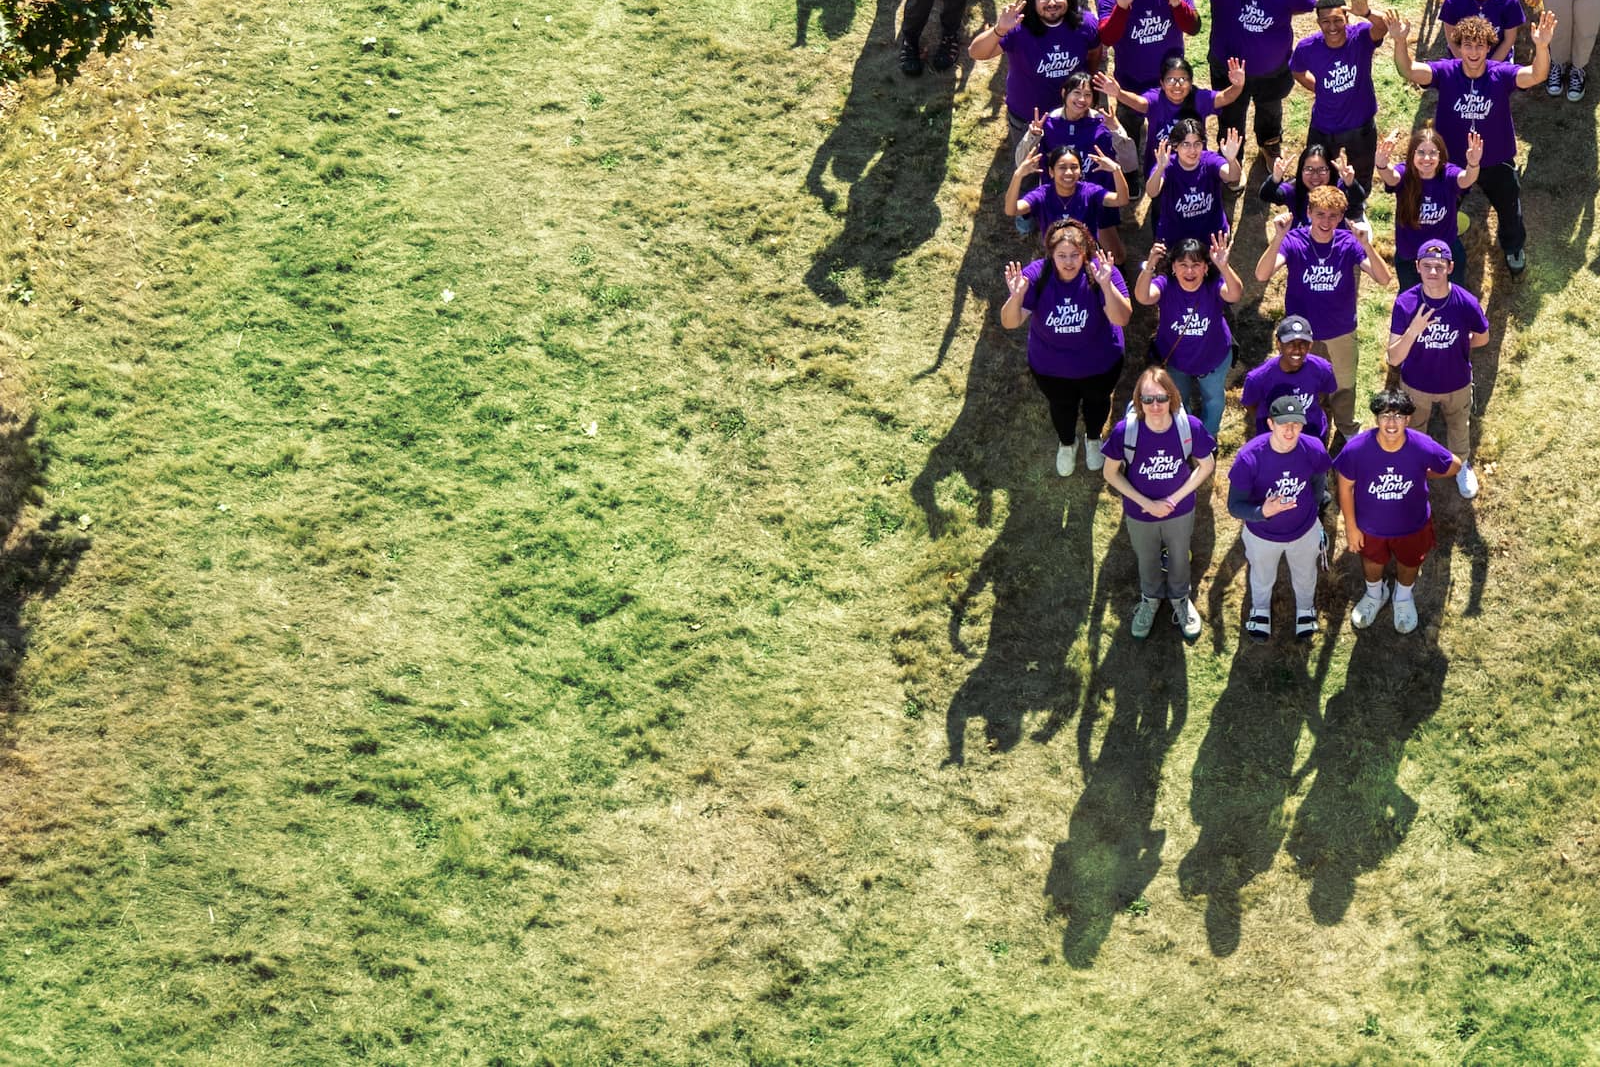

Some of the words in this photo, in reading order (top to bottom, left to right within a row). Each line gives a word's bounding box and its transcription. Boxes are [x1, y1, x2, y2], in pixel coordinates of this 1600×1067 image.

[1245, 4, 1264, 16] YOU
[1140, 16, 1161, 26] YOU
[1131, 18, 1171, 40] belong
[1243, 23, 1264, 32] HERE
[1139, 34, 1164, 45] HERE
[1047, 51, 1069, 60] YOU
[1037, 55, 1080, 73] belong
[1045, 69, 1069, 78] HERE
[1328, 65, 1349, 77] YOU
[1323, 65, 1357, 90] belong
[1333, 80, 1355, 94] HERE
[1464, 94, 1483, 103] YOU
[1454, 97, 1494, 116] belong
[1461, 112, 1484, 120] HERE
[1176, 192, 1213, 212] belong
[1185, 193, 1204, 203] YOU
[1312, 266, 1333, 274] YOU
[1303, 270, 1342, 285] belong
[1311, 283, 1334, 291] HERE
[1056, 305, 1078, 314] YOU
[1046, 309, 1088, 326] belong
[1427, 324, 1449, 332] YOU
[1417, 329, 1459, 344] belong
[1425, 341, 1448, 349] HERE
[1149, 457, 1173, 465] YOU
[1139, 458, 1183, 476] belong
[1148, 472, 1174, 480] HERE
[1379, 475, 1403, 484] YOU
[1277, 477, 1298, 486] YOU
[1368, 479, 1414, 494] belong
[1377, 492, 1404, 501] HERE
